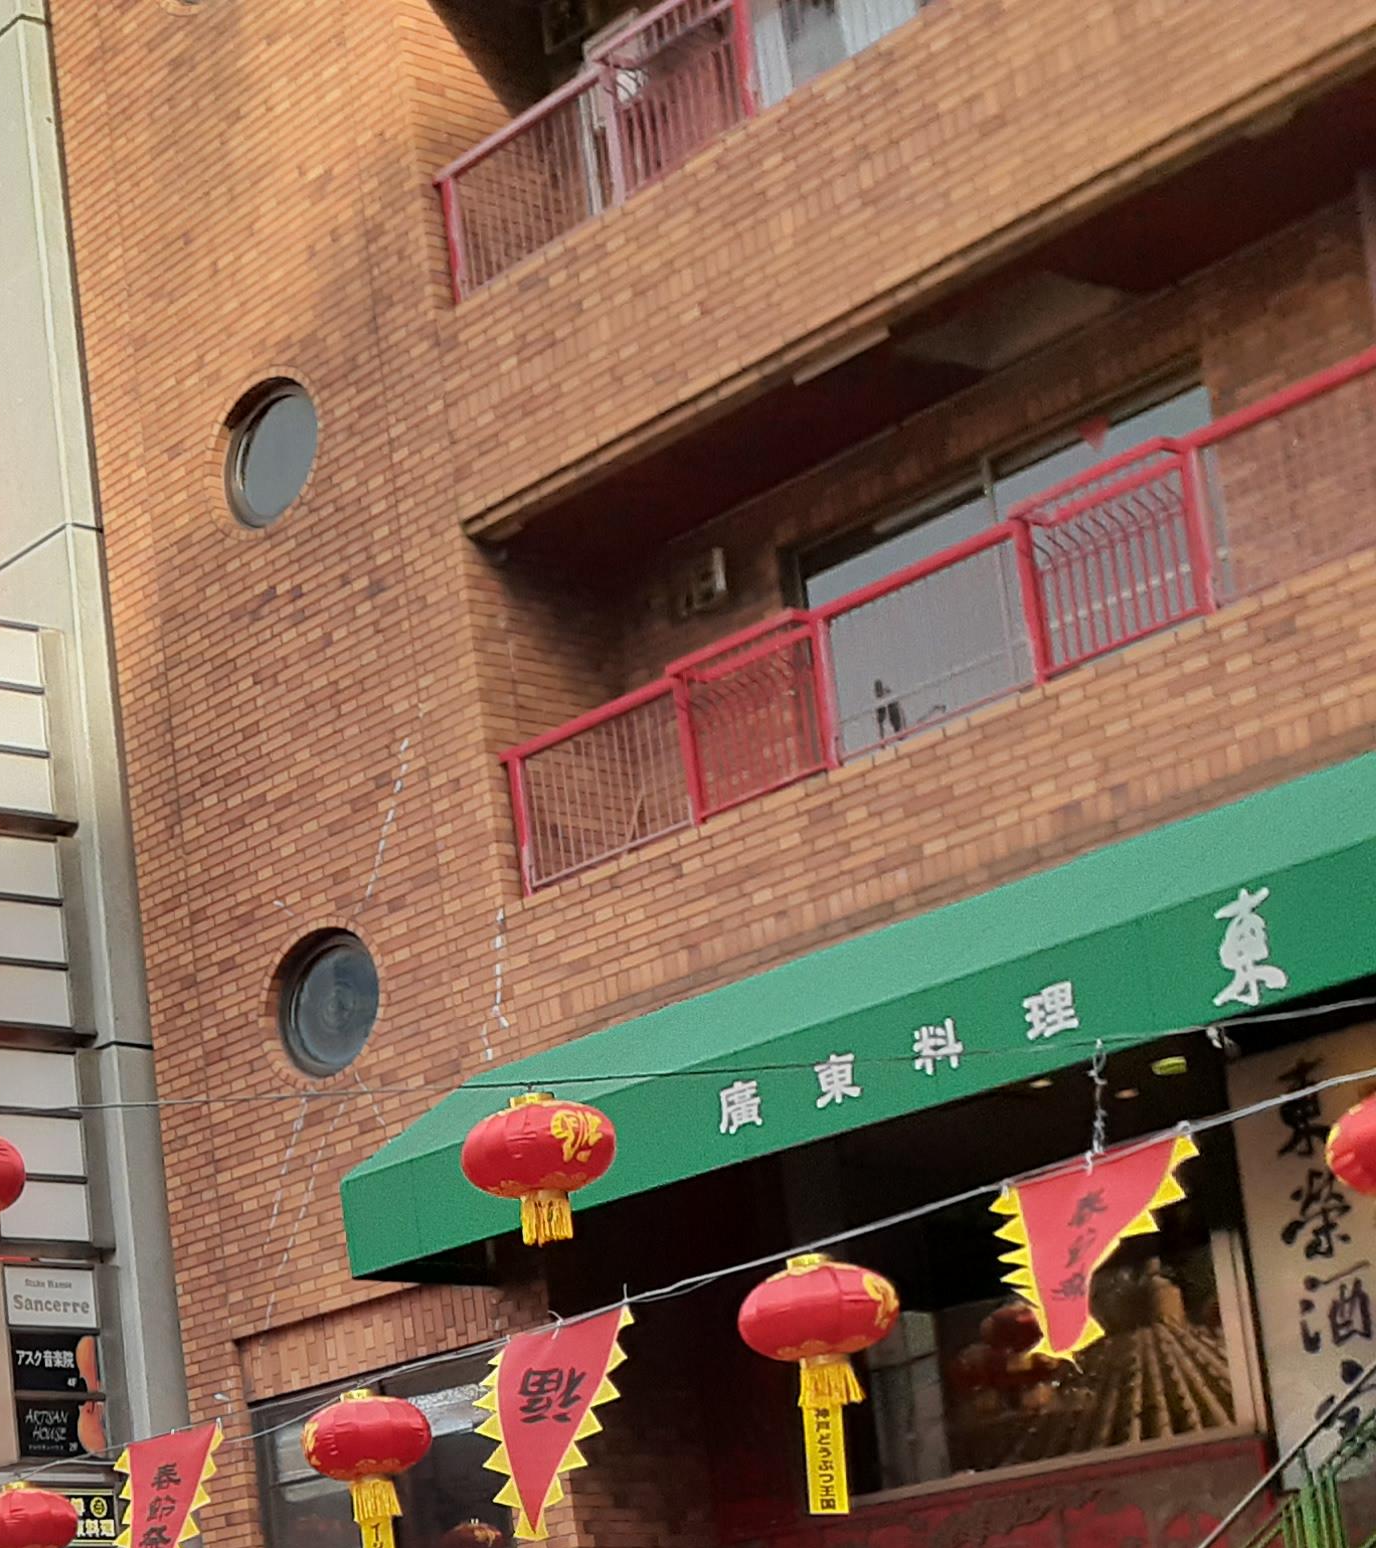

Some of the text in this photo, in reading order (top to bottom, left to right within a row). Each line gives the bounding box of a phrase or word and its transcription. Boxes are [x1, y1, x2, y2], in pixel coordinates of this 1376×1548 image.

[1212, 887, 1288, 1006] 東
[13, 1294, 90, 1314] Sancerre
[16, 1350, 75, 1369] アスク音楽院
